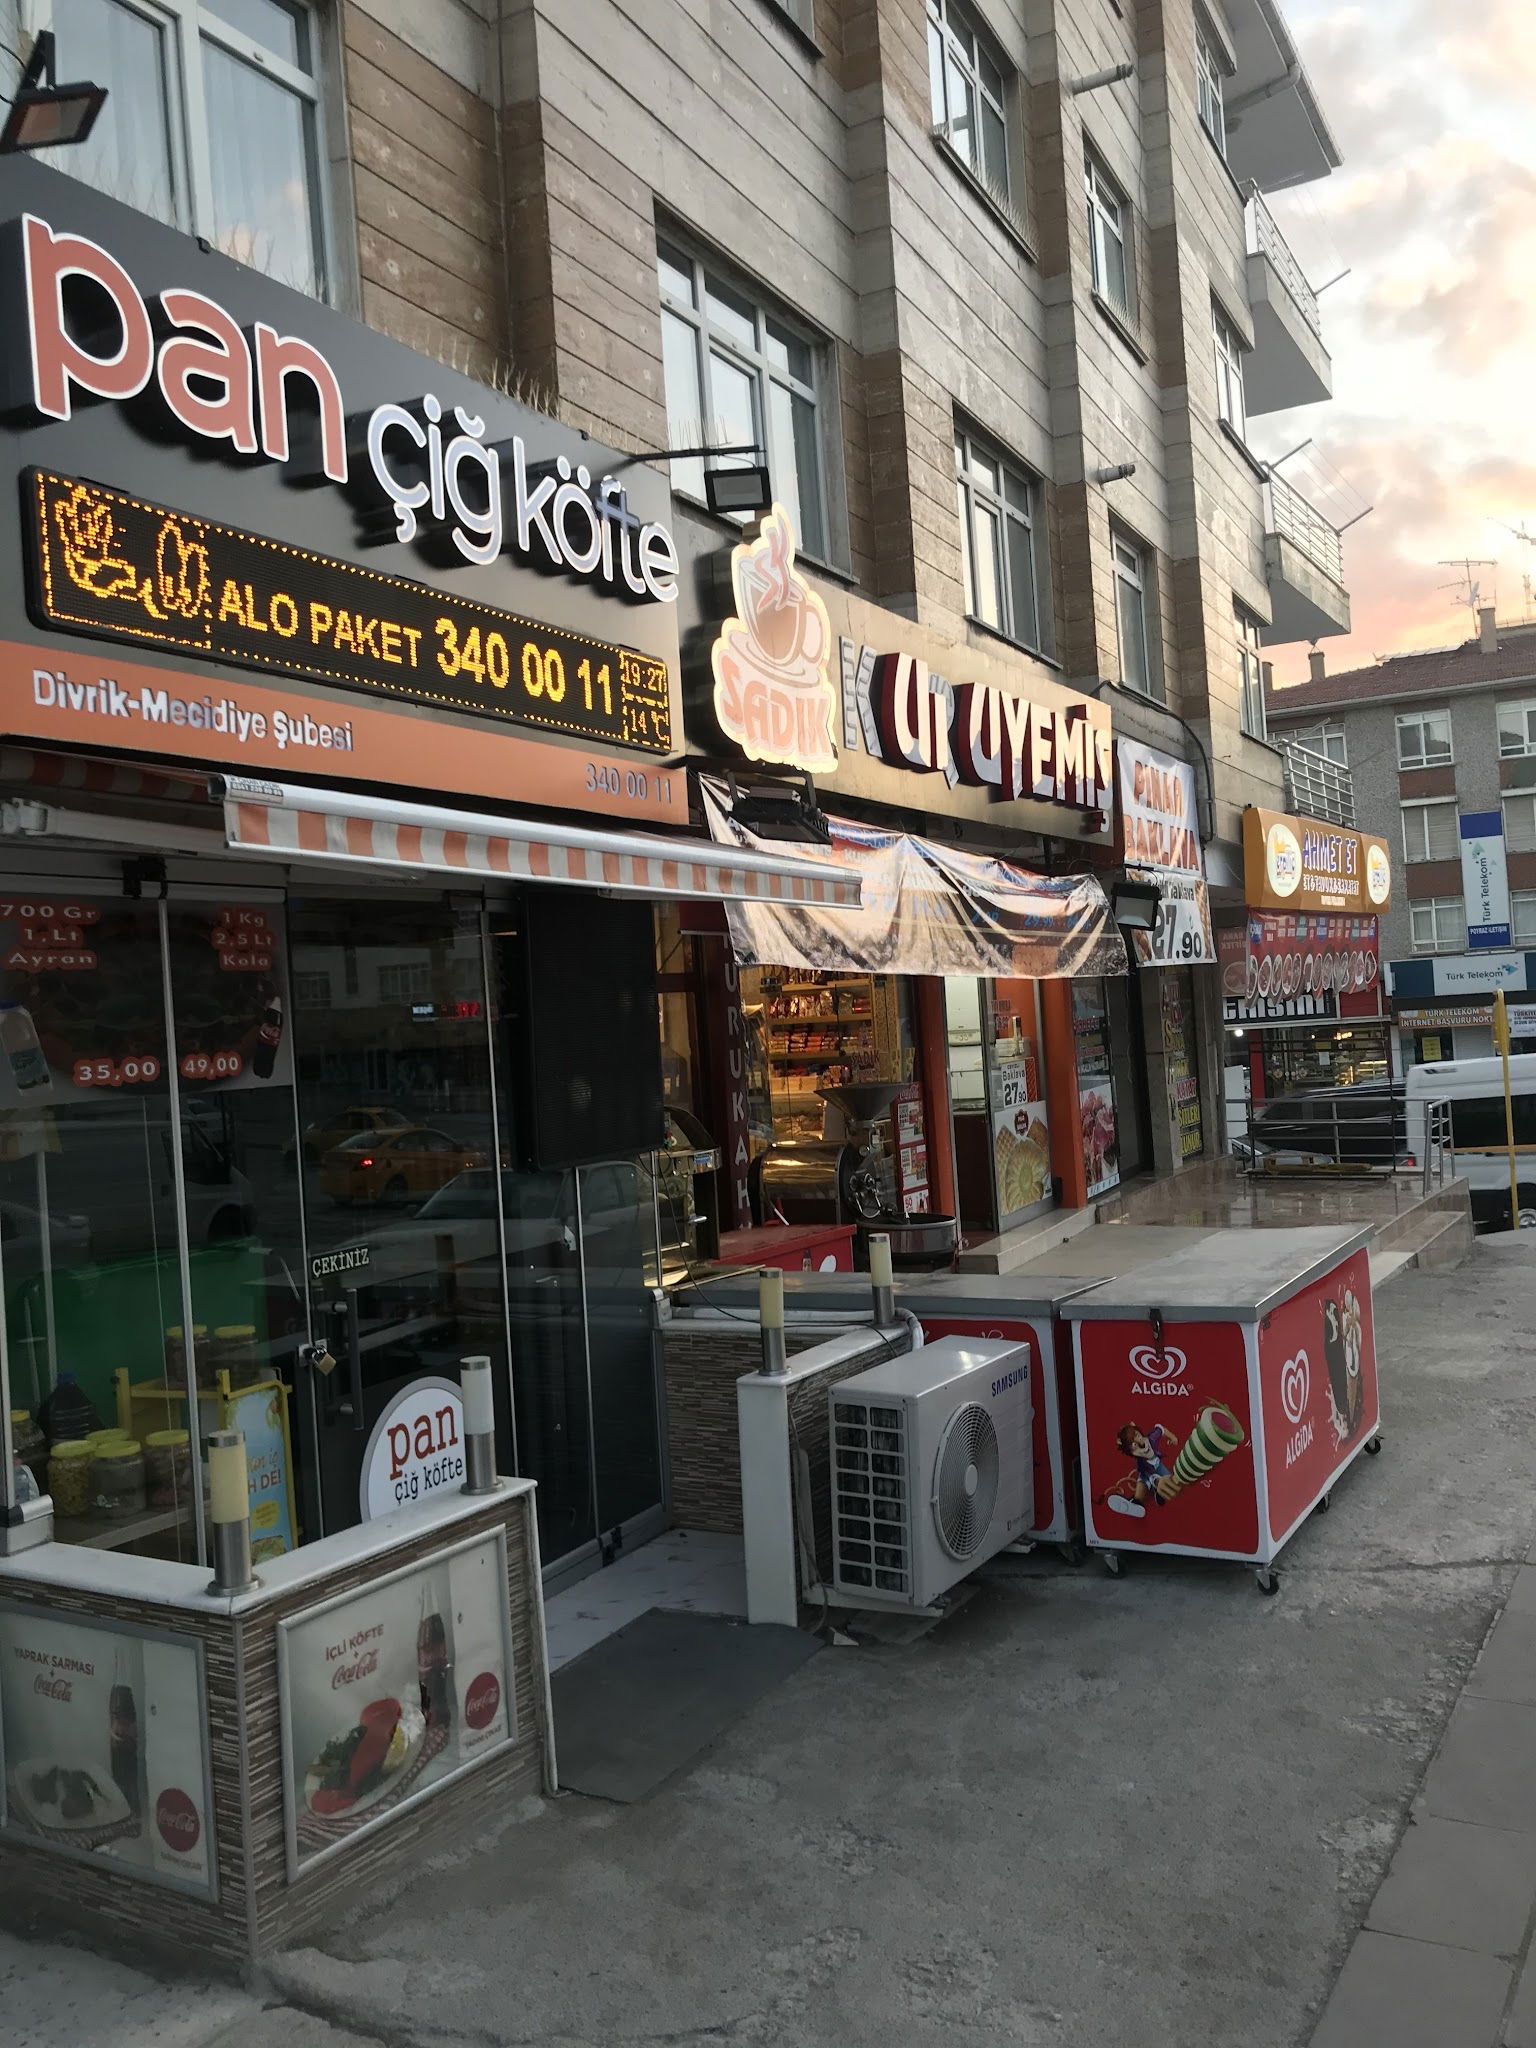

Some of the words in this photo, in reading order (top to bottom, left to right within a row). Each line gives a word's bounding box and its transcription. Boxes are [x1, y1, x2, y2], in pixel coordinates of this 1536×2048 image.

[22, 212, 347, 484] pan
[367, 393, 500, 565] çiğ
[513, 436, 679, 602] köfte
[218, 578, 300, 638] ALO
[309, 603, 423, 669] PAKET
[436, 617, 510, 689] 340
[522, 641, 565, 703] 00
[577, 657, 613, 716] 11
[622, 660, 664, 693] 19:27
[33, 668, 269, 741] Divrik-Mecidiye
[272, 710, 355, 752] Şubesi
[720, 654, 831, 760] SADIK
[584, 763, 621, 796] 340
[625, 771, 649, 801] 00
[653, 776, 672, 804] 11
[1302, 828, 1342, 874] AHMET
[1480, 857, 1490, 898] Telekom
[1, 904, 55, 919] 700
[63, 906, 96, 920] Gr
[239, 913, 265, 927] Kg
[1482, 901, 1491, 922] Türk
[8, 951, 94, 967] Ayran
[222, 953, 270, 967] Kola
[1446, 973, 1465, 981] Türk
[1467, 971, 1503, 980] Telekom
[1401, 1018, 1435, 1027] İNTERNET
[1436, 1017, 1471, 1026] BAŞVURU
[1424, 1008, 1445, 1017] TÜRK
[1446, 1007, 1479, 1016] TELEKOM
[78, 1061, 157, 1081] 35,00
[184, 1056, 240, 1075] 49,00
[1002, 1069, 1025, 1081] Baklava
[312, 1247, 370, 1277] ÇEKİNİZ
[991, 1365, 1029, 1397] SAMSUNG
[387, 1403, 459, 1481] pan
[394, 1468, 421, 1506] çiğ
[423, 1454, 464, 1488] köfte
[14, 1647, 50, 1666] YAPRAK
[325, 1639, 347, 1661] İÇLİ
[349, 1624, 385, 1650] KÖFTE
